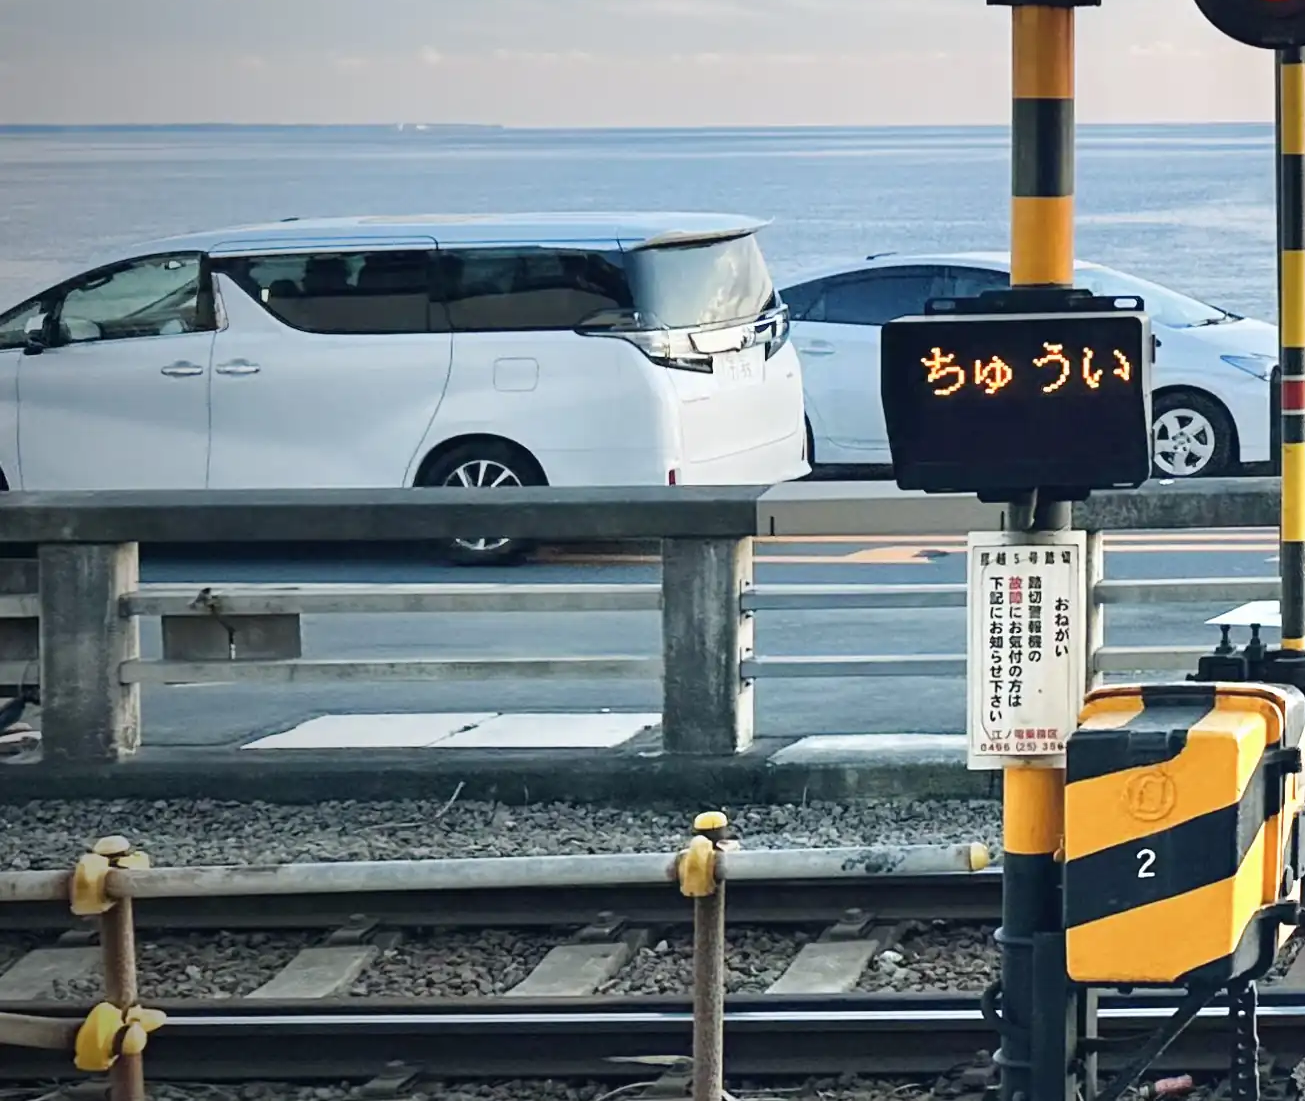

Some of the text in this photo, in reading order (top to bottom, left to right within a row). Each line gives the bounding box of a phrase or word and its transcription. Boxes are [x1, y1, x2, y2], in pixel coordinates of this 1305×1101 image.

[920, 341, 1132, 396] ちゅうい
[1028, 576, 1042, 662] 踏切警報機の
[1054, 597, 1069, 657] おねがい
[989, 577, 1004, 723] 下記にお知らせ下さい
[1136, 848, 1157, 879] 2
